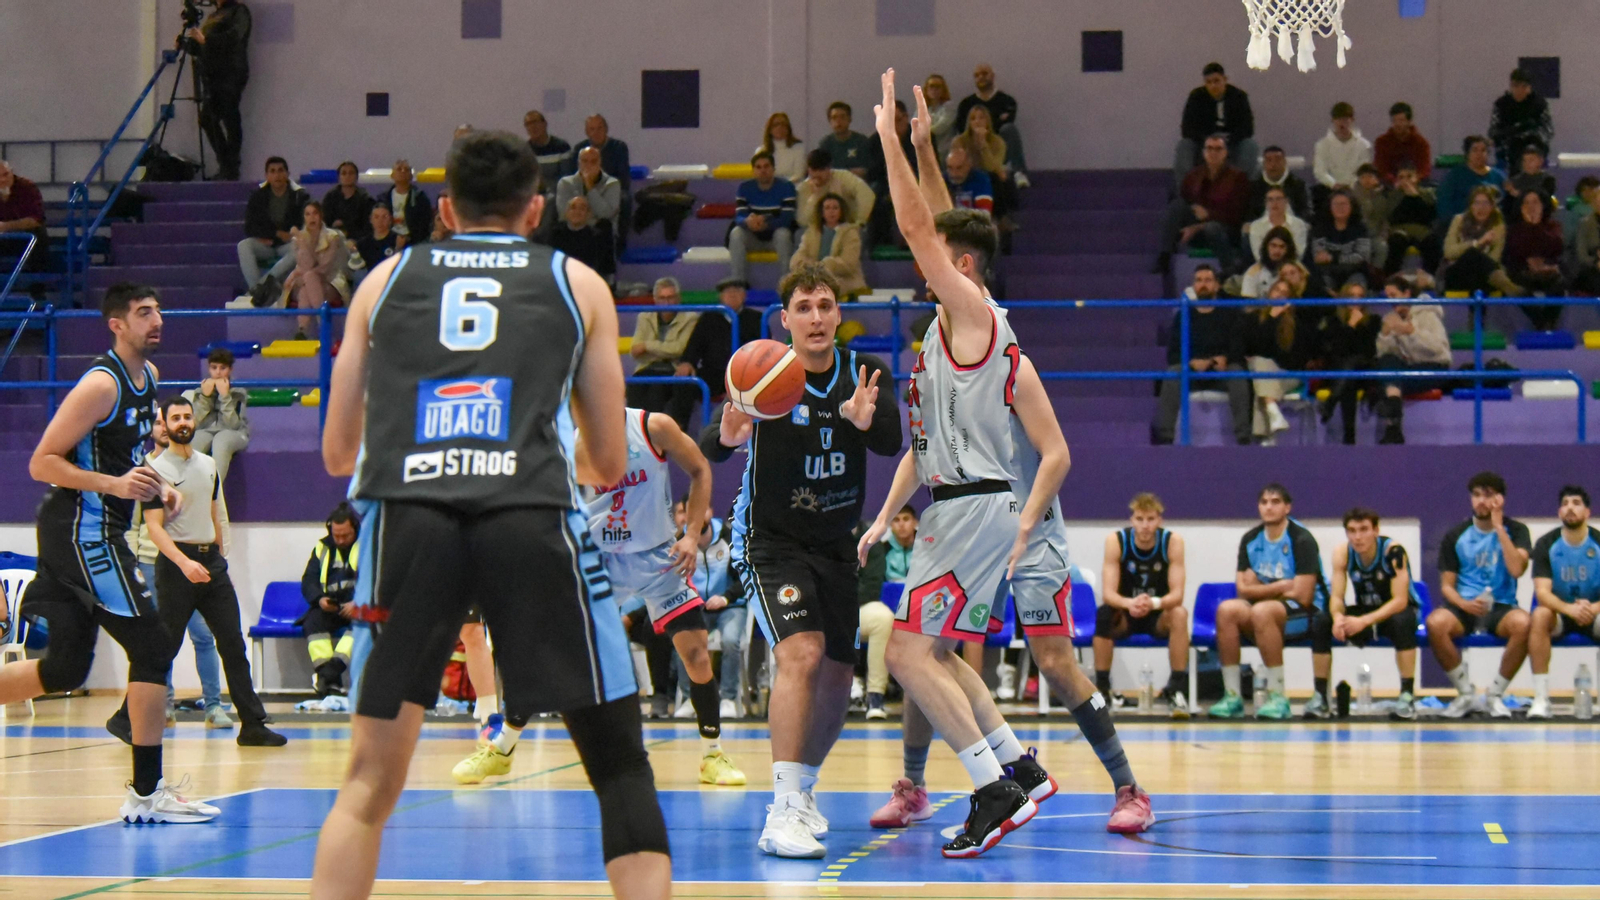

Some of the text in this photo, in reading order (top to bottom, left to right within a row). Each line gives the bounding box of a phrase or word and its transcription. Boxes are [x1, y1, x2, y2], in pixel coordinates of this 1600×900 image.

[430, 249, 530, 269] TORRES
[439, 277, 503, 351] 6
[424, 402, 503, 439] UBAGO
[820, 427, 833, 450] 0
[444, 447, 518, 476] STROG
[804, 451, 846, 480] ULB
[602, 527, 632, 541] hita
[1140, 573, 1149, 588] 7
[782, 608, 808, 621] vive
